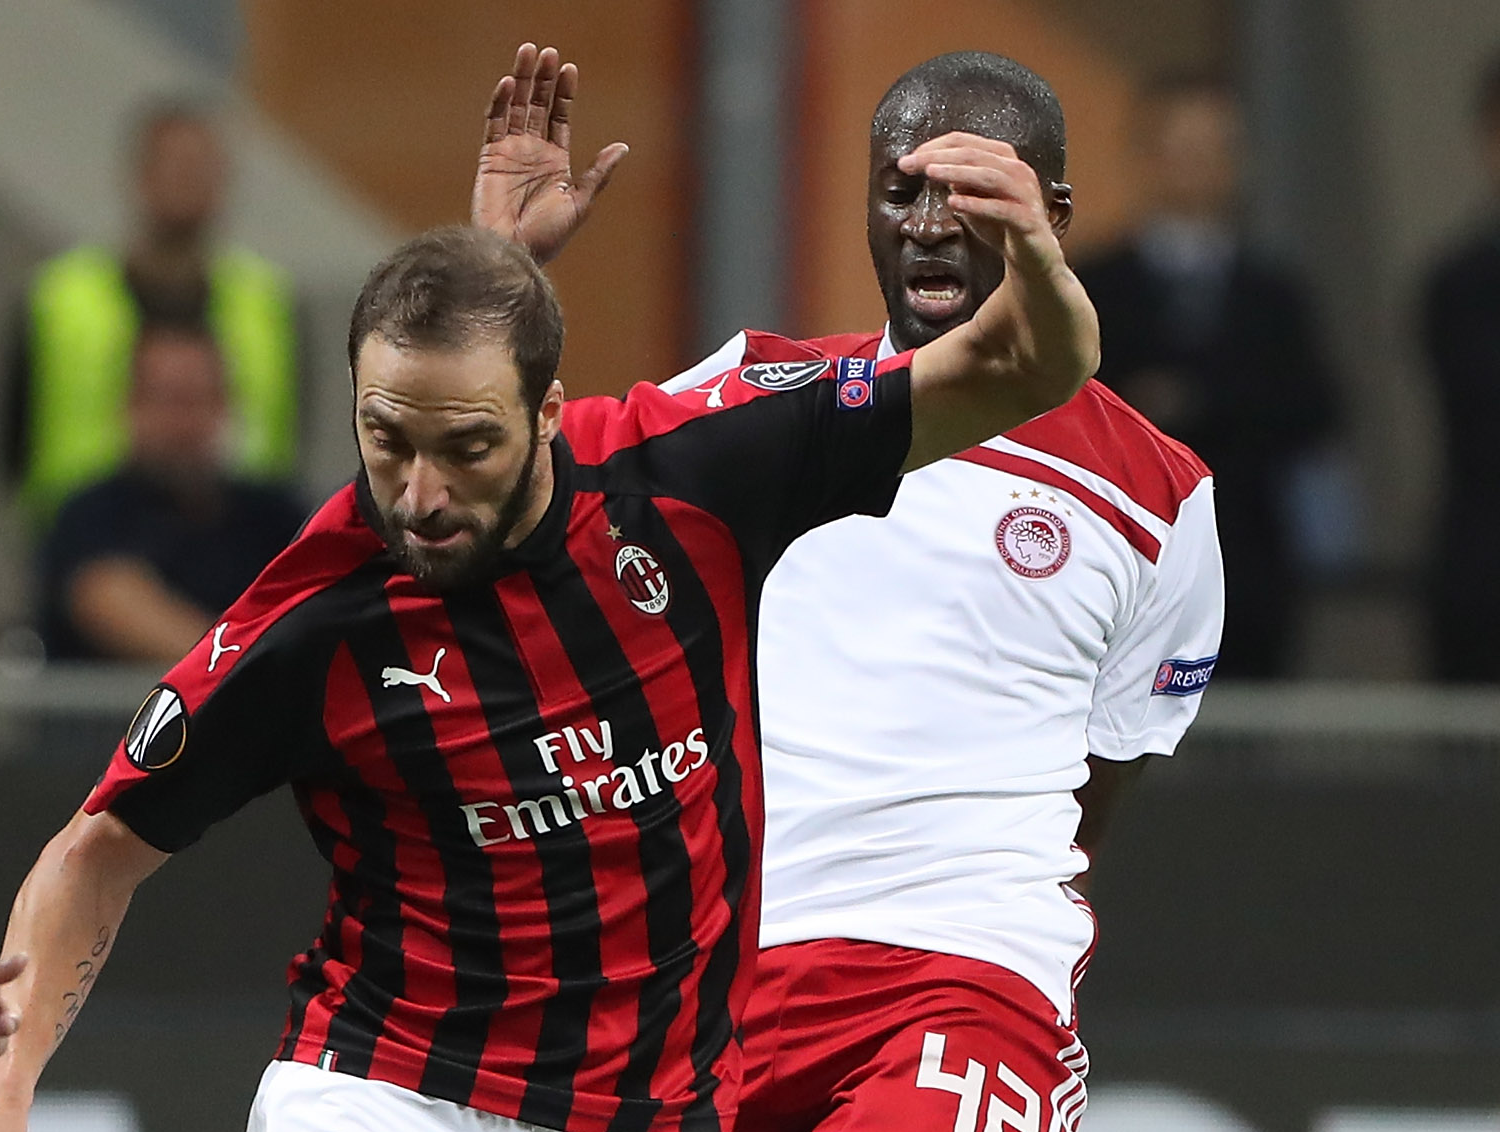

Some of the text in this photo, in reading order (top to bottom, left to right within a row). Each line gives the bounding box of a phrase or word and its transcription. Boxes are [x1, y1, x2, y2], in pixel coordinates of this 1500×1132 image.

[619, 548, 645, 569] ACM
[644, 594, 666, 610] 1899
[533, 720, 614, 774] Fly
[459, 728, 708, 847] Emirates
